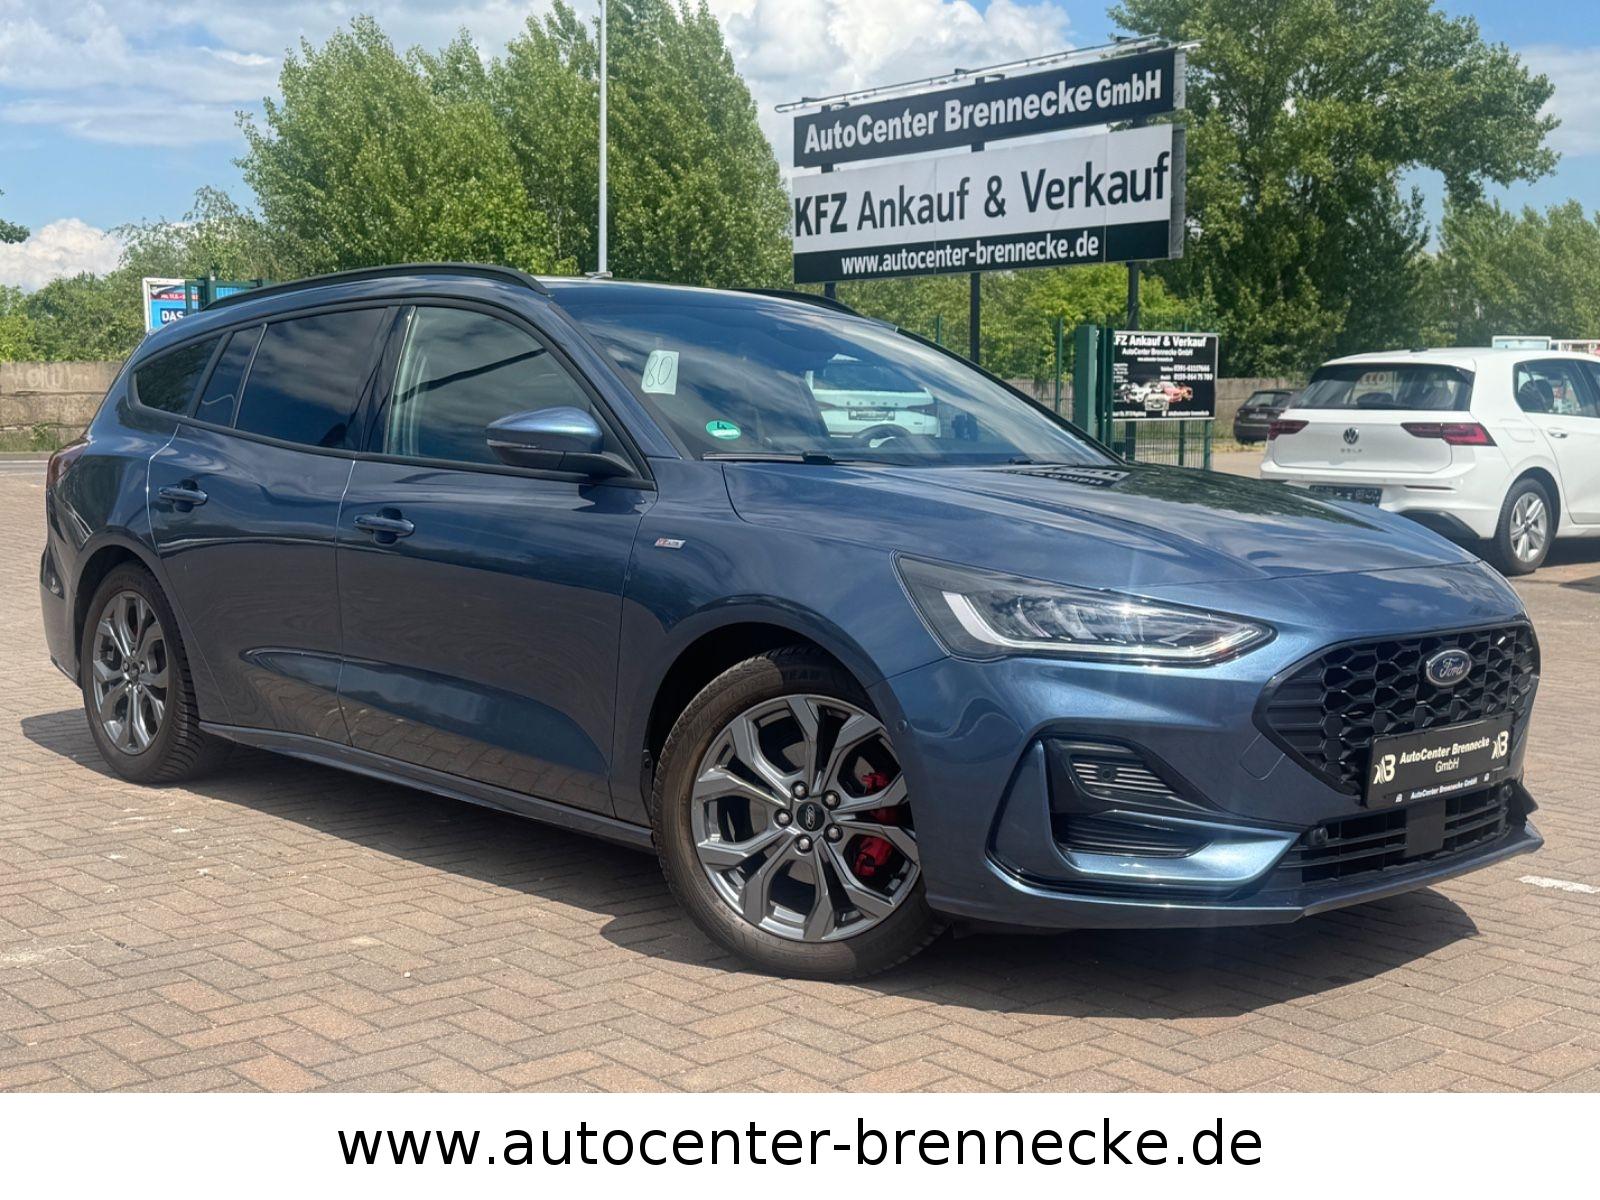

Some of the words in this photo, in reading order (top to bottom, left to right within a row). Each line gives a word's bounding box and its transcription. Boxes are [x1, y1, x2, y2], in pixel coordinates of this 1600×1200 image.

[804, 108, 938, 154] AutoCenter
[944, 80, 1092, 132] Brennecke
[1096, 69, 1161, 108] GmbH
[795, 192, 847, 236] KFZ
[856, 176, 970, 230] Ankauf
[984, 175, 1006, 218] &
[1020, 151, 1170, 214] Verkauf
[841, 230, 1099, 275] www.autocenter-brennecke.de
[1129, 335, 1161, 347] Ankauf
[1163, 336, 1171, 347] &
[1172, 336, 1207, 347] Verkauf
[645, 354, 673, 388] 80
[1439, 657, 1464, 678] Ford
[1399, 745, 1451, 765] AutoCenter
[1451, 736, 1490, 756] Brennecke
[1435, 757, 1459, 773] GmbH
[1410, 786, 1439, 800] AutoCenter
